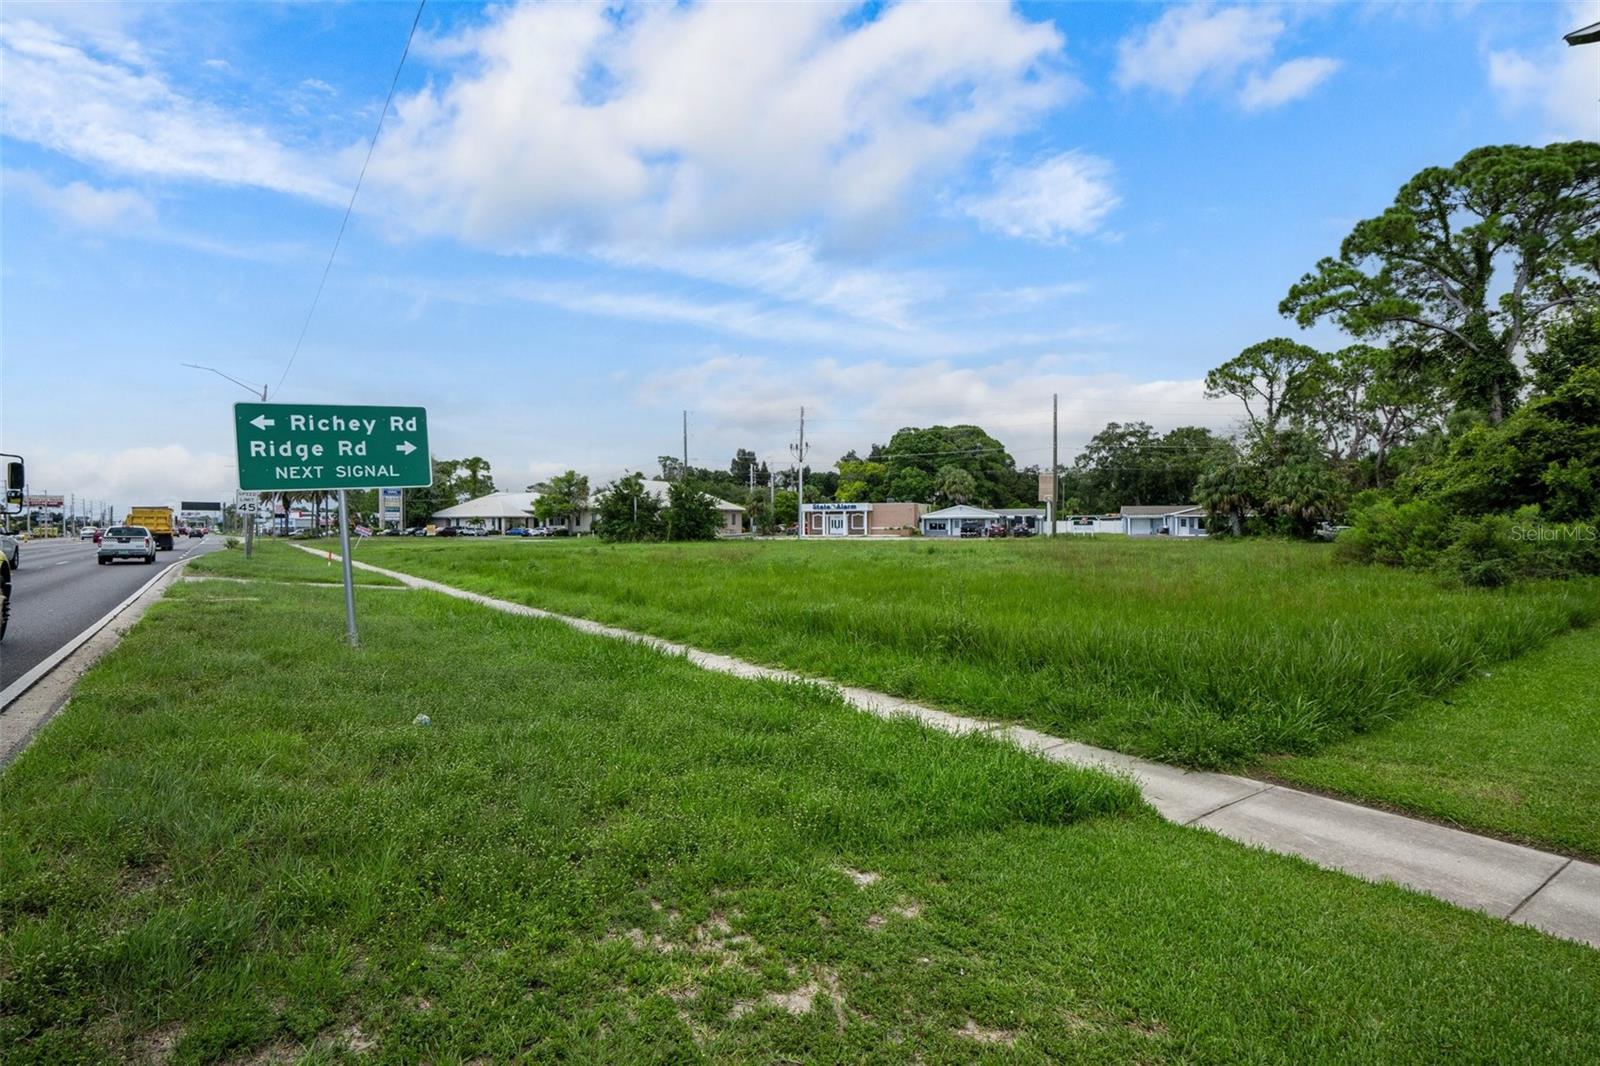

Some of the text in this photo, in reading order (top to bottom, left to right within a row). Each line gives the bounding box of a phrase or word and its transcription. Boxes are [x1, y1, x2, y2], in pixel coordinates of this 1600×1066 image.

[290, 414, 417, 435] Richey Rd
[250, 440, 367, 461] Ridge Rd
[275, 465, 400, 479] NEXT SIGNAL
[239, 503, 256, 511] 45
